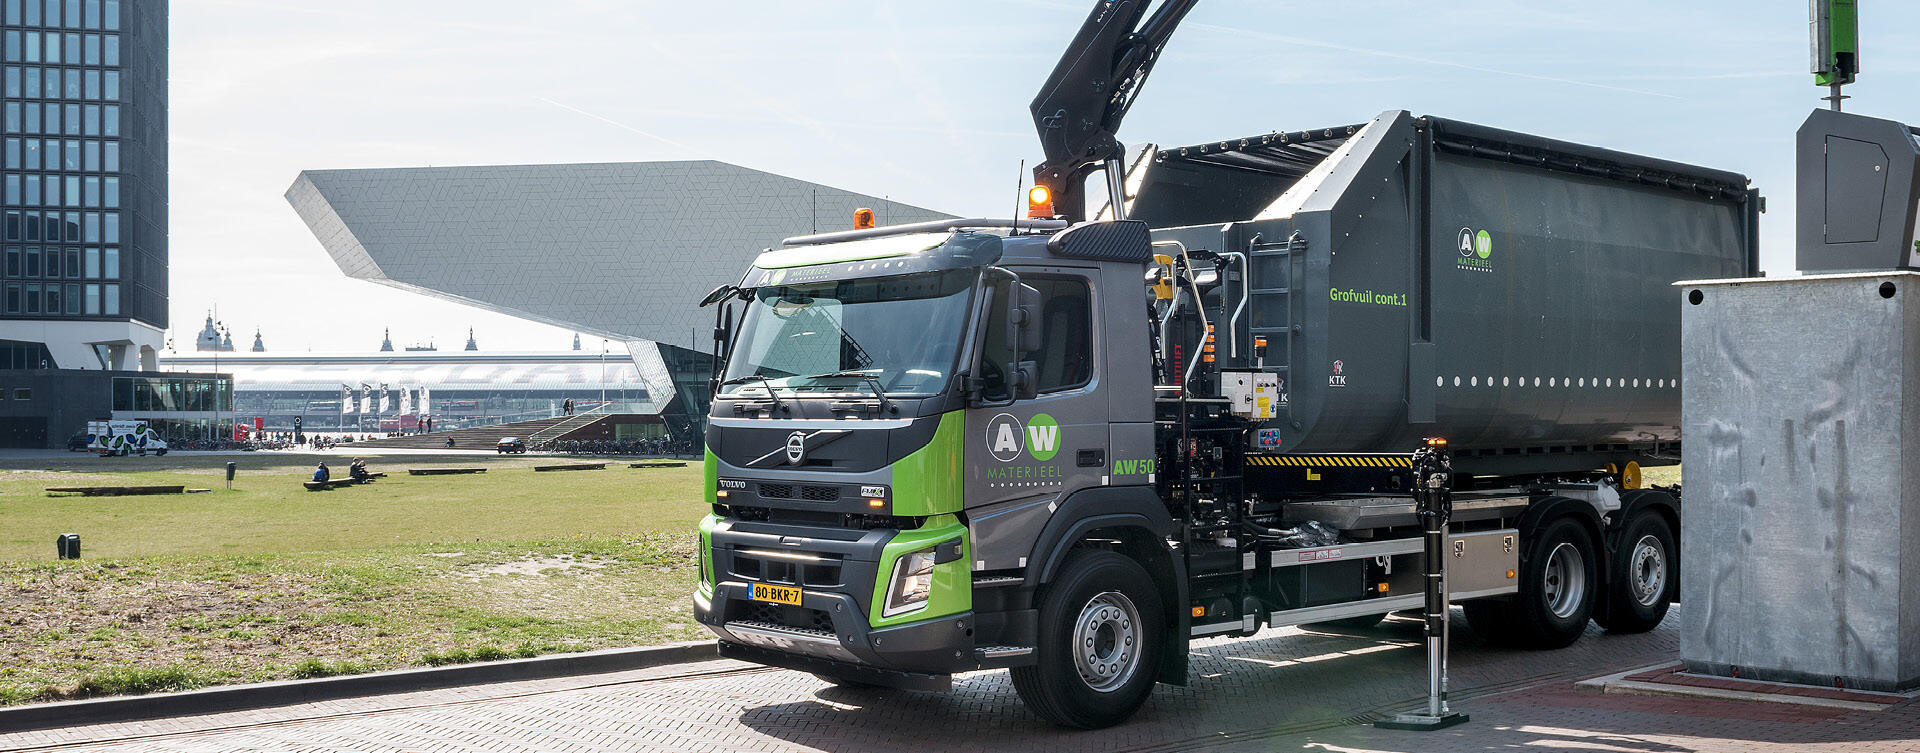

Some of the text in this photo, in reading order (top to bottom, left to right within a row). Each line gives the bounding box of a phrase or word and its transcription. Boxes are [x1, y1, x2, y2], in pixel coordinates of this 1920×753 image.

[1461, 233, 1490, 253] AW
[1457, 257, 1492, 268] MATERIEEL
[1329, 287, 1407, 306] Grofvuil cont.1
[1329, 375, 1346, 385] KTK
[994, 423, 1058, 452] AW
[987, 465, 1062, 479] MATERIEEL
[1113, 458, 1154, 475] AW 50
[719, 479, 746, 489] VOLVO
[755, 586, 800, 602] 80-BKR-7
